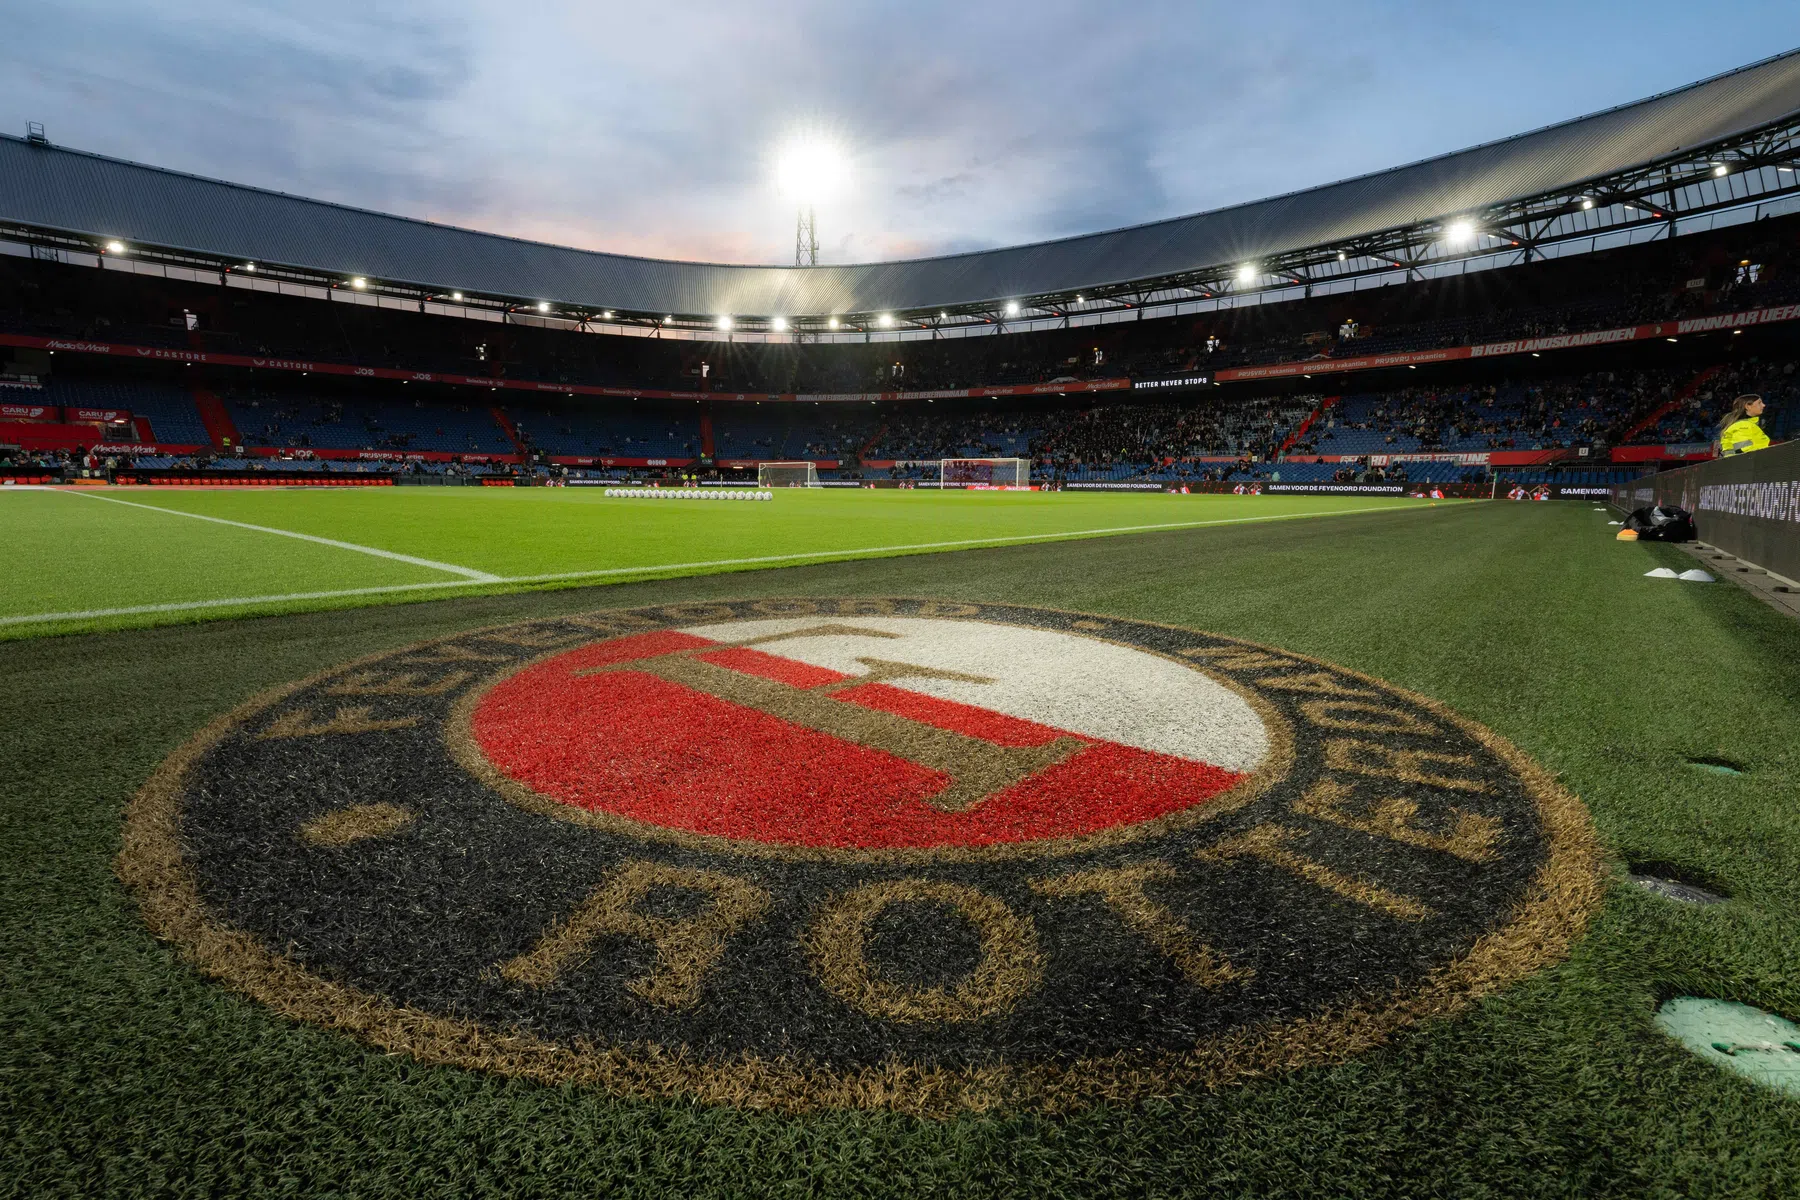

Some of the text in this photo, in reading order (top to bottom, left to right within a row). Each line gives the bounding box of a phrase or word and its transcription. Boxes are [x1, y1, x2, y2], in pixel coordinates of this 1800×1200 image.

[1678, 310, 1760, 333] WINNAAR
[1485, 342, 1519, 356] KEER
[1518, 328, 1637, 353] LANDSKAMPIOEN
[156, 350, 206, 361] CASTORE
[1412, 352, 1447, 360] vakanties
[269, 360, 314, 370] CASTORE
[1336, 360, 1368, 368] vakanties
[1268, 367, 1297, 375] vakanties
[1134, 377, 1208, 389] BETTER NEVER STOPS
[1359, 485, 1403, 493] FOUNDATION
[1560, 487, 1590, 495] SAMEN
[1737, 482, 1788, 520] FEYENOORD
[487, 645, 1506, 1024] ROTTERDAM
